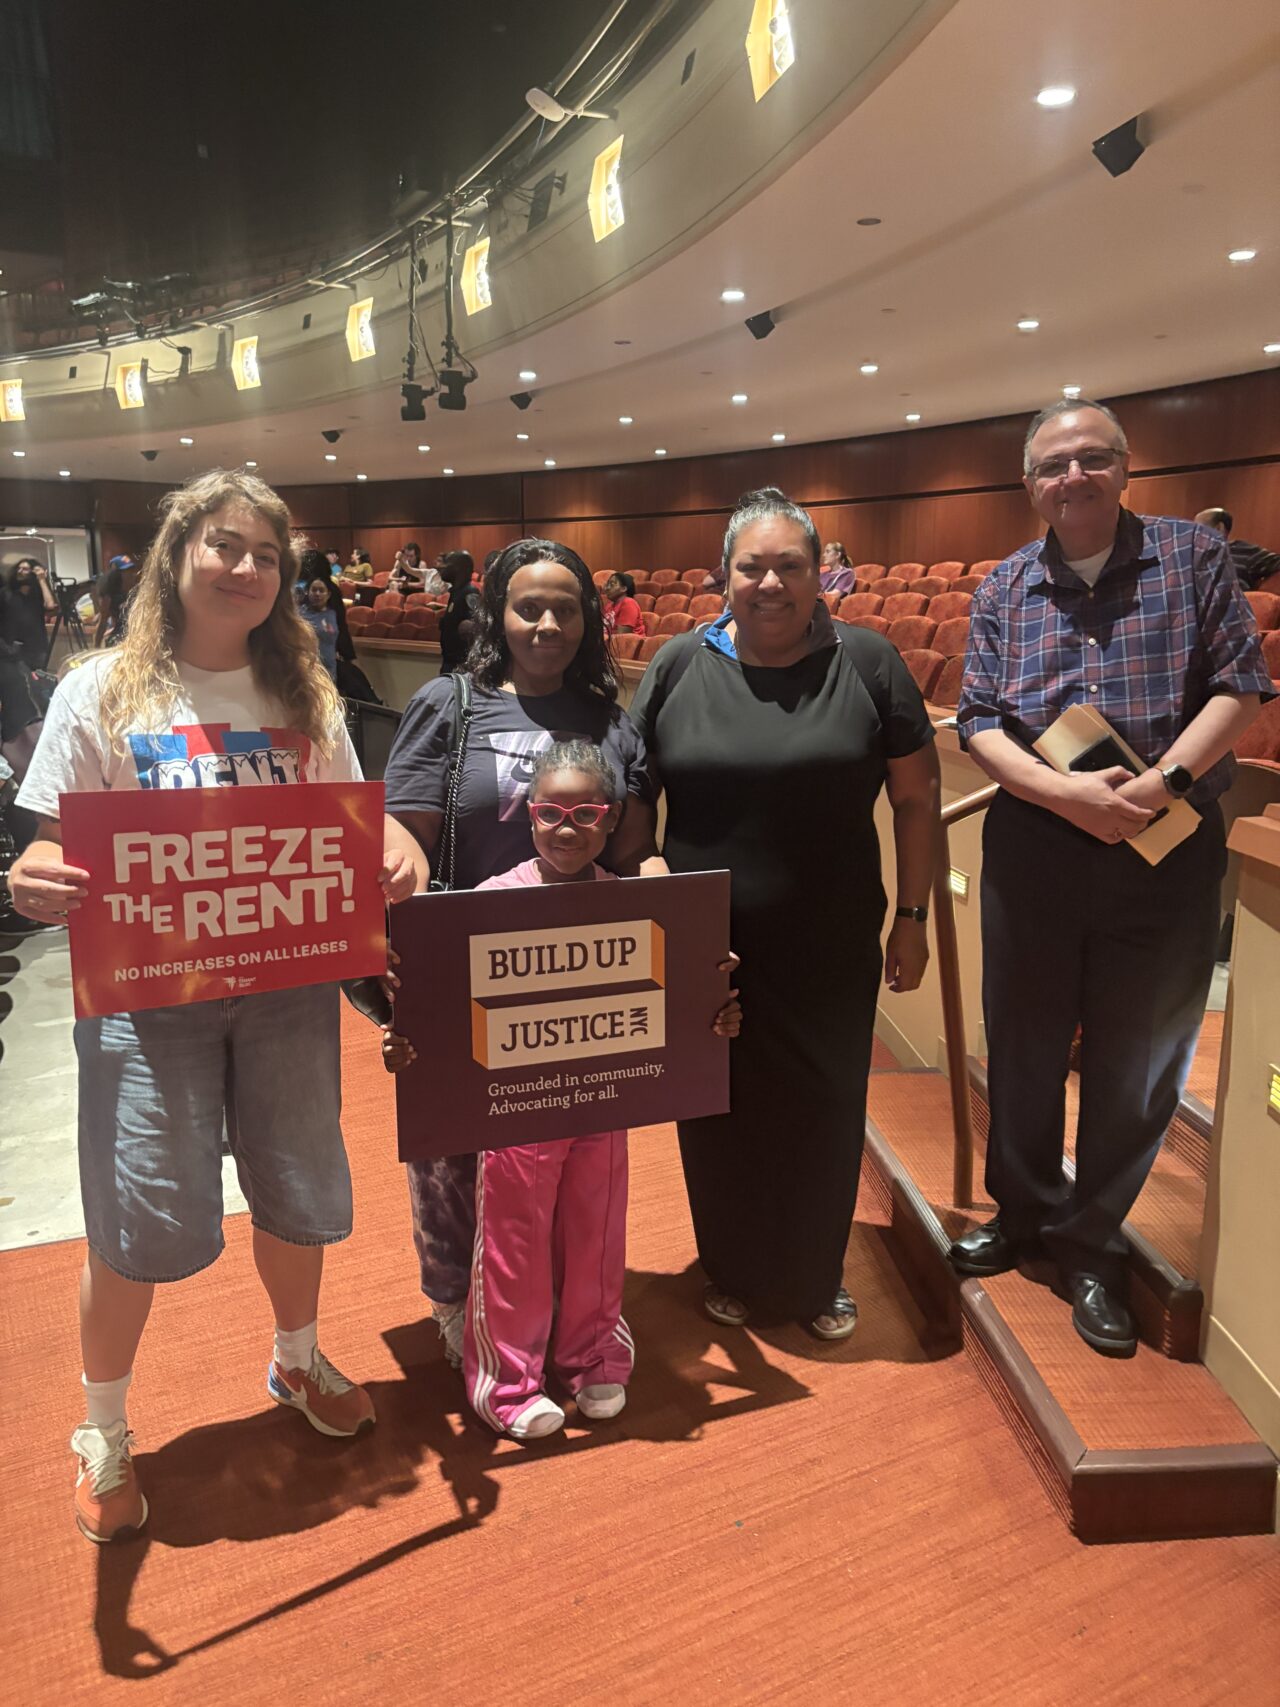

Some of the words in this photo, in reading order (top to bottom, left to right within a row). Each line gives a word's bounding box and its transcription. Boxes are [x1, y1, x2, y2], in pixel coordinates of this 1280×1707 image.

[113, 825, 345, 884] FREEZE
[104, 894, 174, 933] THE
[183, 867, 355, 941] RENT!
[114, 967, 140, 982] NO
[144, 955, 235, 978] INCREASES
[238, 951, 262, 966] ON
[263, 946, 291, 963] ALL
[293, 940, 348, 957] LEASES
[488, 941, 589, 980] BUILD
[593, 937, 637, 968] UP
[500, 1010, 625, 1052] JUSTICE
[630, 1007, 648, 1037] NYC
[488, 1075, 561, 1096] Grounded
[564, 1072, 580, 1087] in
[583, 1062, 665, 1083] community.
[488, 1094, 571, 1115] Advocating
[574, 1089, 595, 1103] for
[598, 1085, 619, 1100] all.
